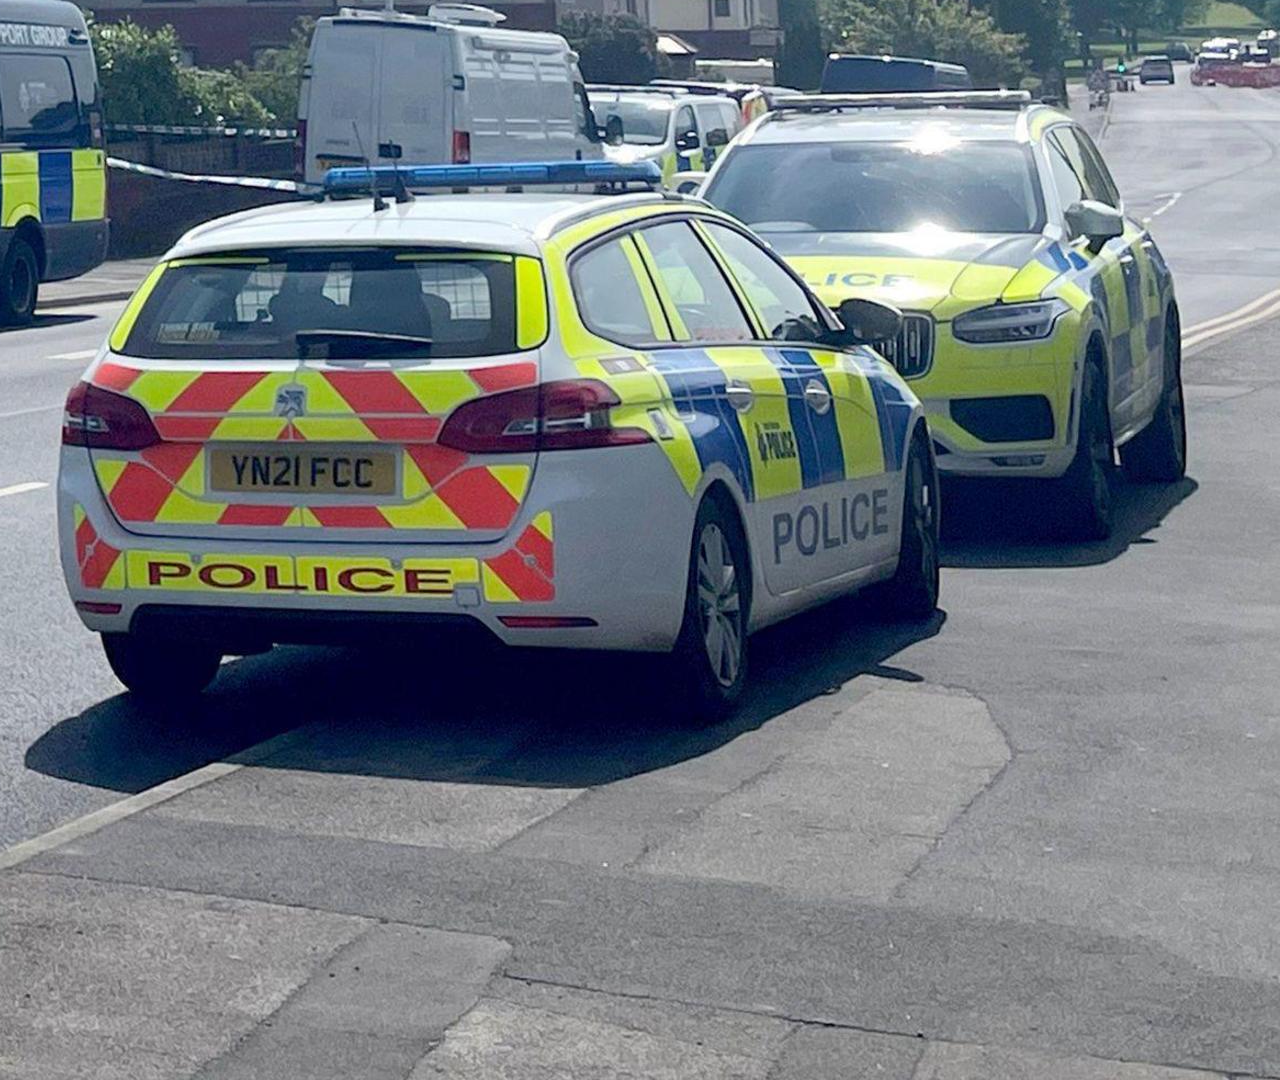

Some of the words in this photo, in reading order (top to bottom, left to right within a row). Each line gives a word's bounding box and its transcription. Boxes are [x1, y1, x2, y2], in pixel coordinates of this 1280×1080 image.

[30, 26, 67, 47] GROUP
[765, 431, 797, 460] POLICE
[232, 455, 300, 488] YN21
[311, 457, 374, 489] FCC
[773, 489, 888, 565] POLICE
[147, 561, 455, 594] POLICE
